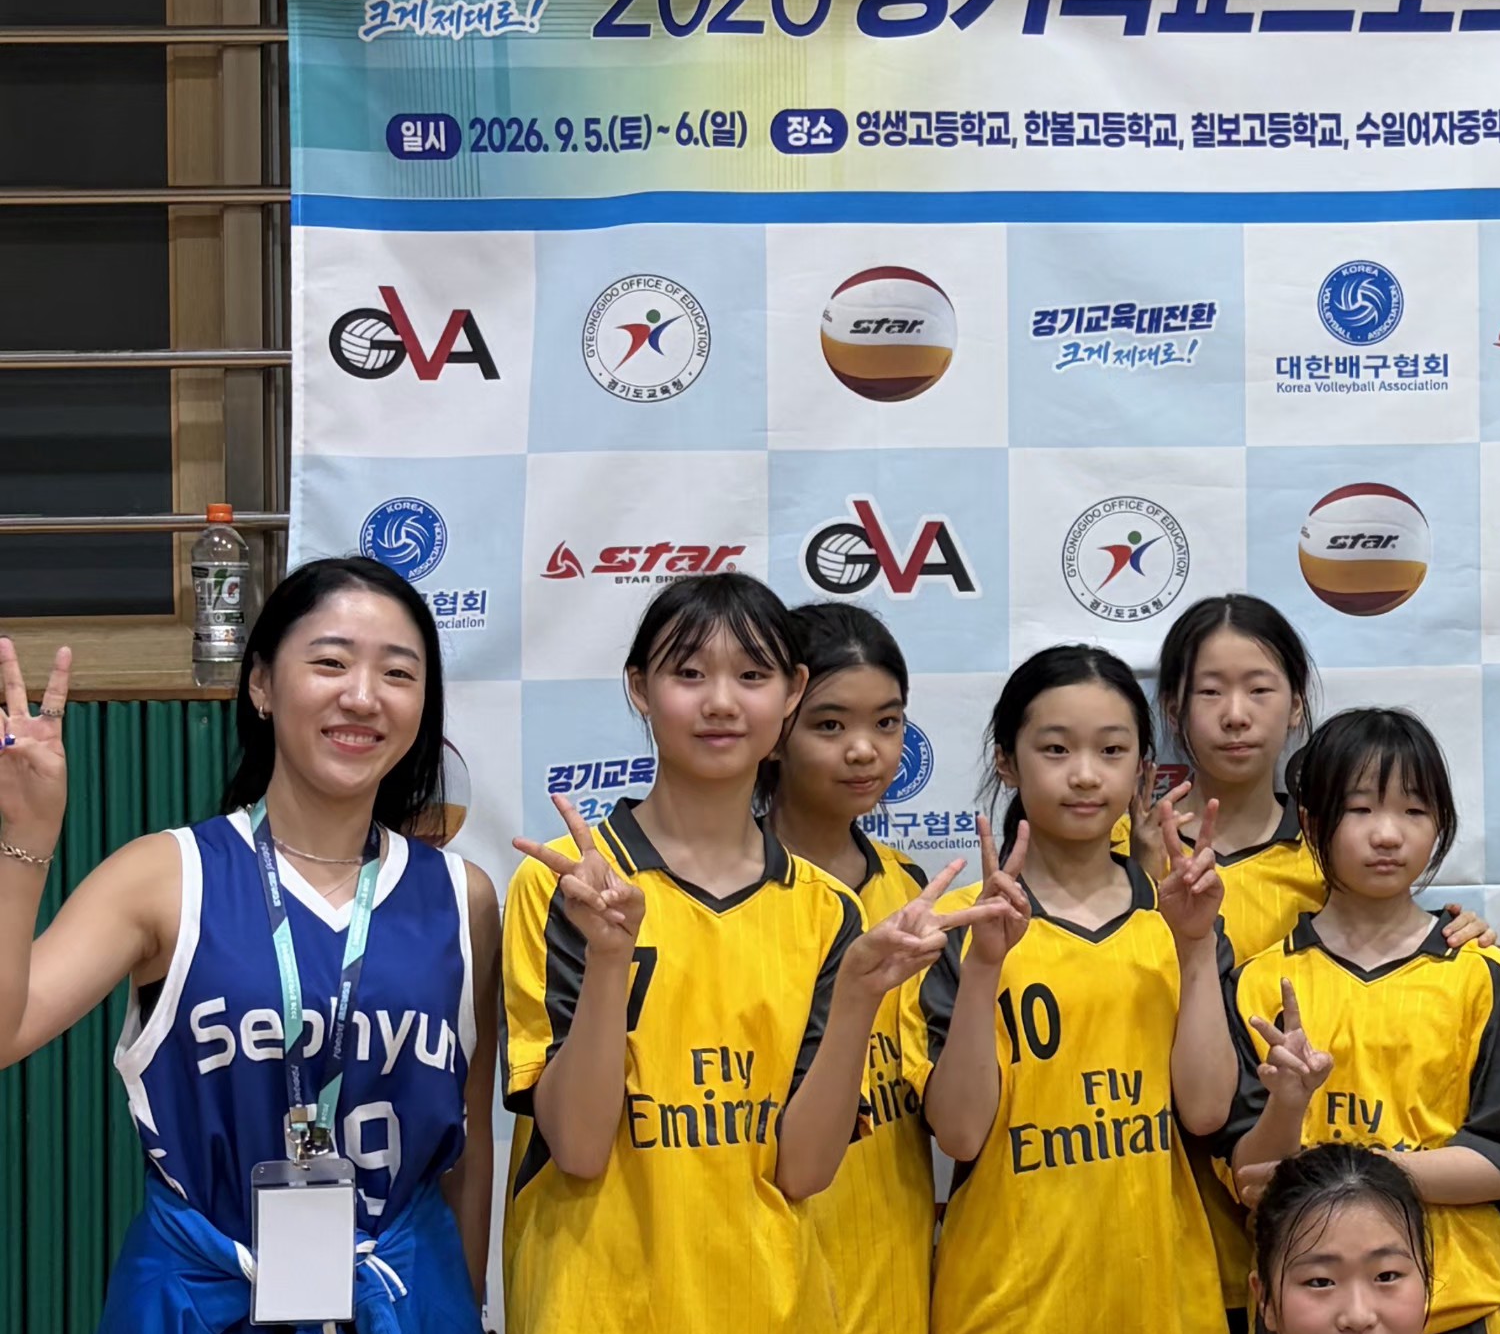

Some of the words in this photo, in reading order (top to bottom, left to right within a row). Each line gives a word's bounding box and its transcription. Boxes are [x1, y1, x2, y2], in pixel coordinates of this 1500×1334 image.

[399, 120, 447, 153] 일시
[469, 117, 549, 153] 2026.
[555, 117, 578, 152] 9.
[785, 114, 835, 148] 장소
[855, 110, 1018, 150] 영생고등학교,
[1024, 110, 1185, 151] 한봄고등학교,
[1191, 110, 1350, 150] 칠보고등학교,
[1342, 265, 1378, 277] KOREA
[329, 285, 500, 380] GVA
[586, 288, 619, 358] GYEONGGIDO
[621, 278, 663, 292] OFFICE
[665, 283, 680, 296] OF
[680, 294, 708, 358] EDUCATION
[849, 318, 924, 334] star
[1032, 301, 1217, 338] 경기교육대전환
[1055, 343, 1107, 370] 크게
[1112, 340, 1198, 369] 제대로!
[1276, 353, 1448, 380] 대한배구협회
[1276, 382, 1311, 393] Korea
[1315, 381, 1375, 395] Volleyball
[1379, 379, 1448, 392] Association
[386, 502, 424, 514] KOREA
[806, 500, 976, 594] GVA
[1066, 508, 1101, 578] GYEONGGIDO
[1102, 500, 1144, 513] OFFICE
[1146, 505, 1162, 517] OF
[1160, 515, 1187, 578] EDUCATION
[1326, 532, 1400, 551] star
[615, 575, 650, 584] STAR
[435, 616, 485, 629] ociation
[547, 757, 656, 794] 경기교육
[862, 811, 980, 838] 배구협회
[908, 837, 980, 850] Association
[997, 982, 1062, 1065] 10
[690, 1046, 755, 1088] Fly
[1081, 1068, 1143, 1106] Fly
[1326, 1092, 1383, 1133] Fly
[1009, 1105, 1173, 1175] Emirat
